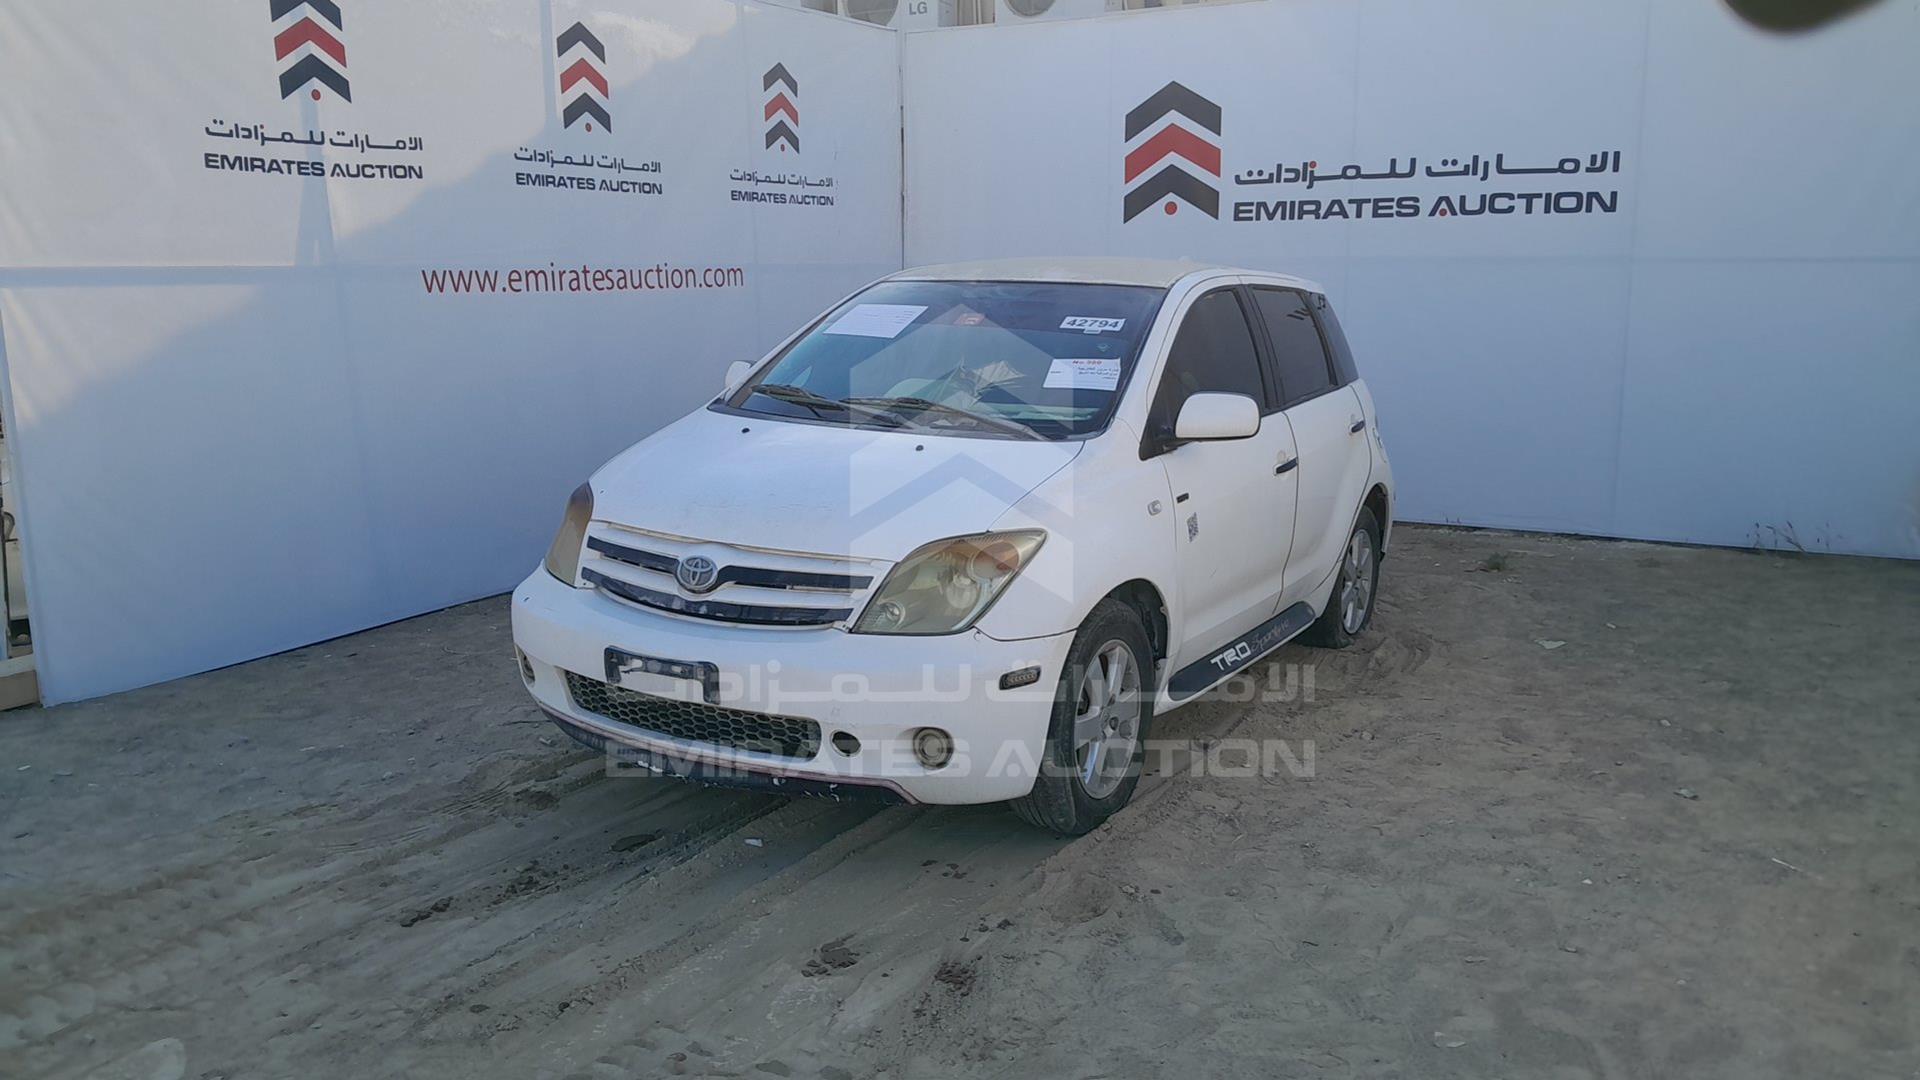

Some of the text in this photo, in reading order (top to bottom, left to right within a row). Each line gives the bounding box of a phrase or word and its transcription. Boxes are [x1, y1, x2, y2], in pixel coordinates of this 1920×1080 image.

[908, 1, 928, 16] LG
[204, 118, 326, 147] للمزادات
[203, 152, 424, 180] EMIRATES AUCTION
[1235, 157, 1418, 190] للمزادات
[515, 172, 663, 195] EMIRATES AUCTION
[730, 189, 834, 207] EMIRATES AUCTION
[1233, 190, 1619, 223] EMIRATES AUCTION
[421, 261, 744, 294] www.emiratesauction.com
[1066, 317, 1120, 329] 42794
[1209, 641, 1252, 671] TRD
